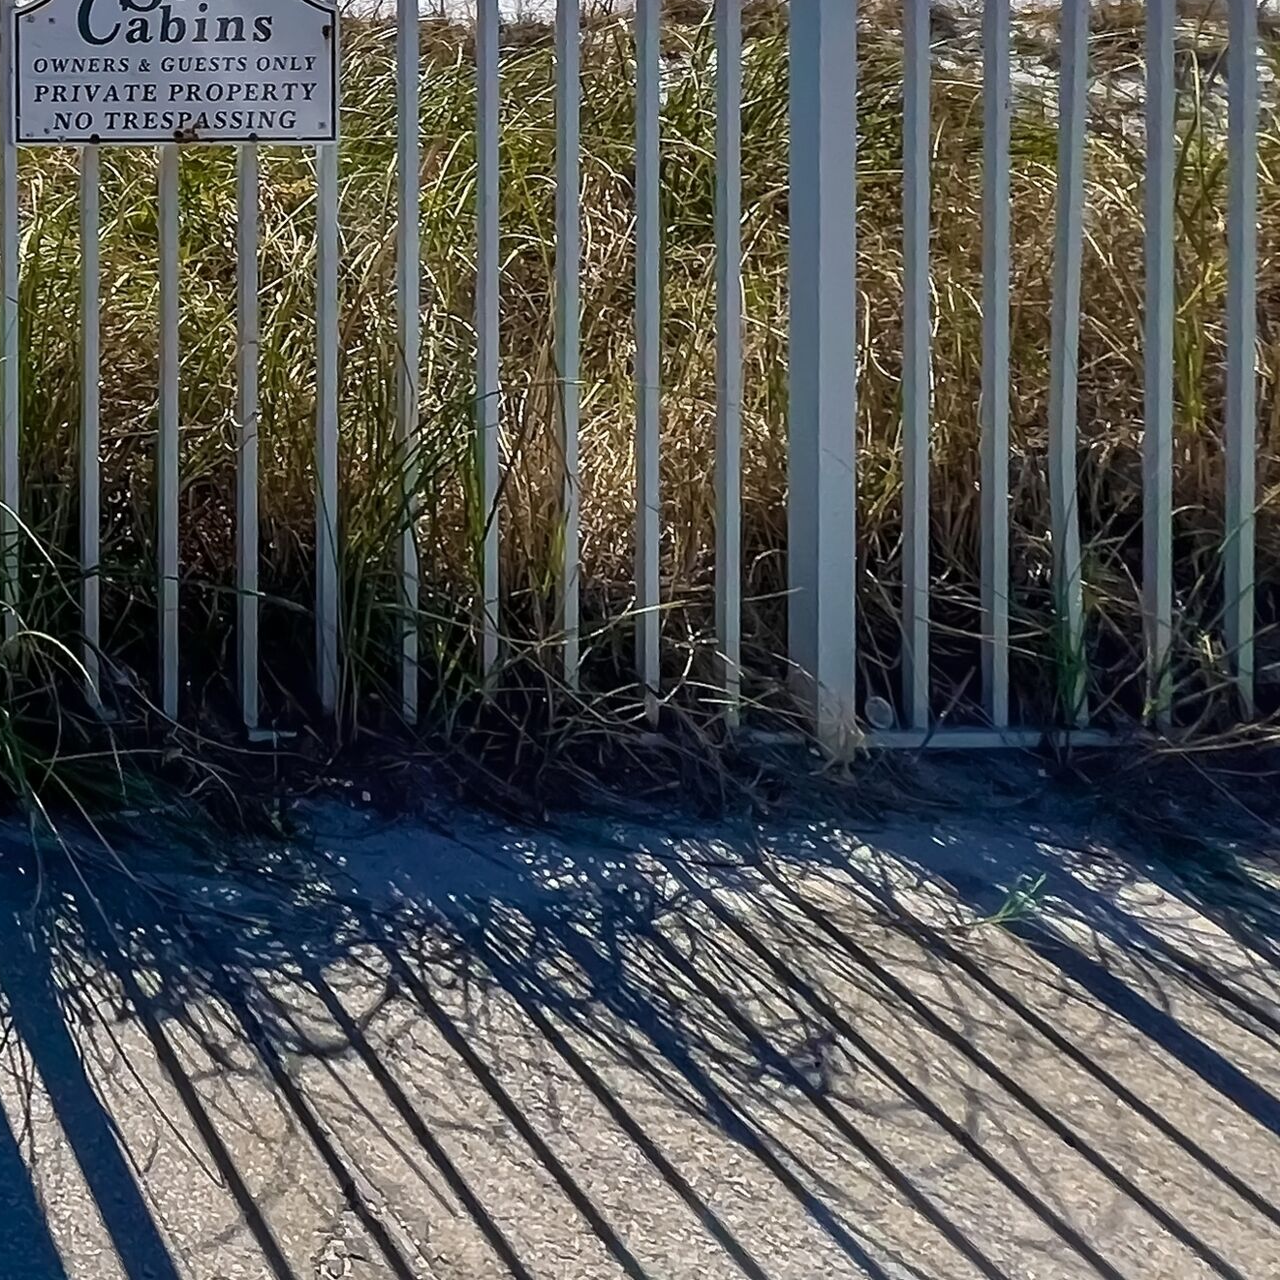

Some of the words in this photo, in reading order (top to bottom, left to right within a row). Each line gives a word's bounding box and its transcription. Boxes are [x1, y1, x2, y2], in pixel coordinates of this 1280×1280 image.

[33, 56, 130, 73] OWNERS
[138, 59, 151, 72] &
[161, 56, 247, 72] GUESTS
[256, 56, 317, 71] ONLY
[33, 84, 158, 103] PRIVATE
[168, 82, 318, 102] PROPERTY
[52, 111, 93, 130] NO
[104, 110, 297, 130] TRESPASSING
